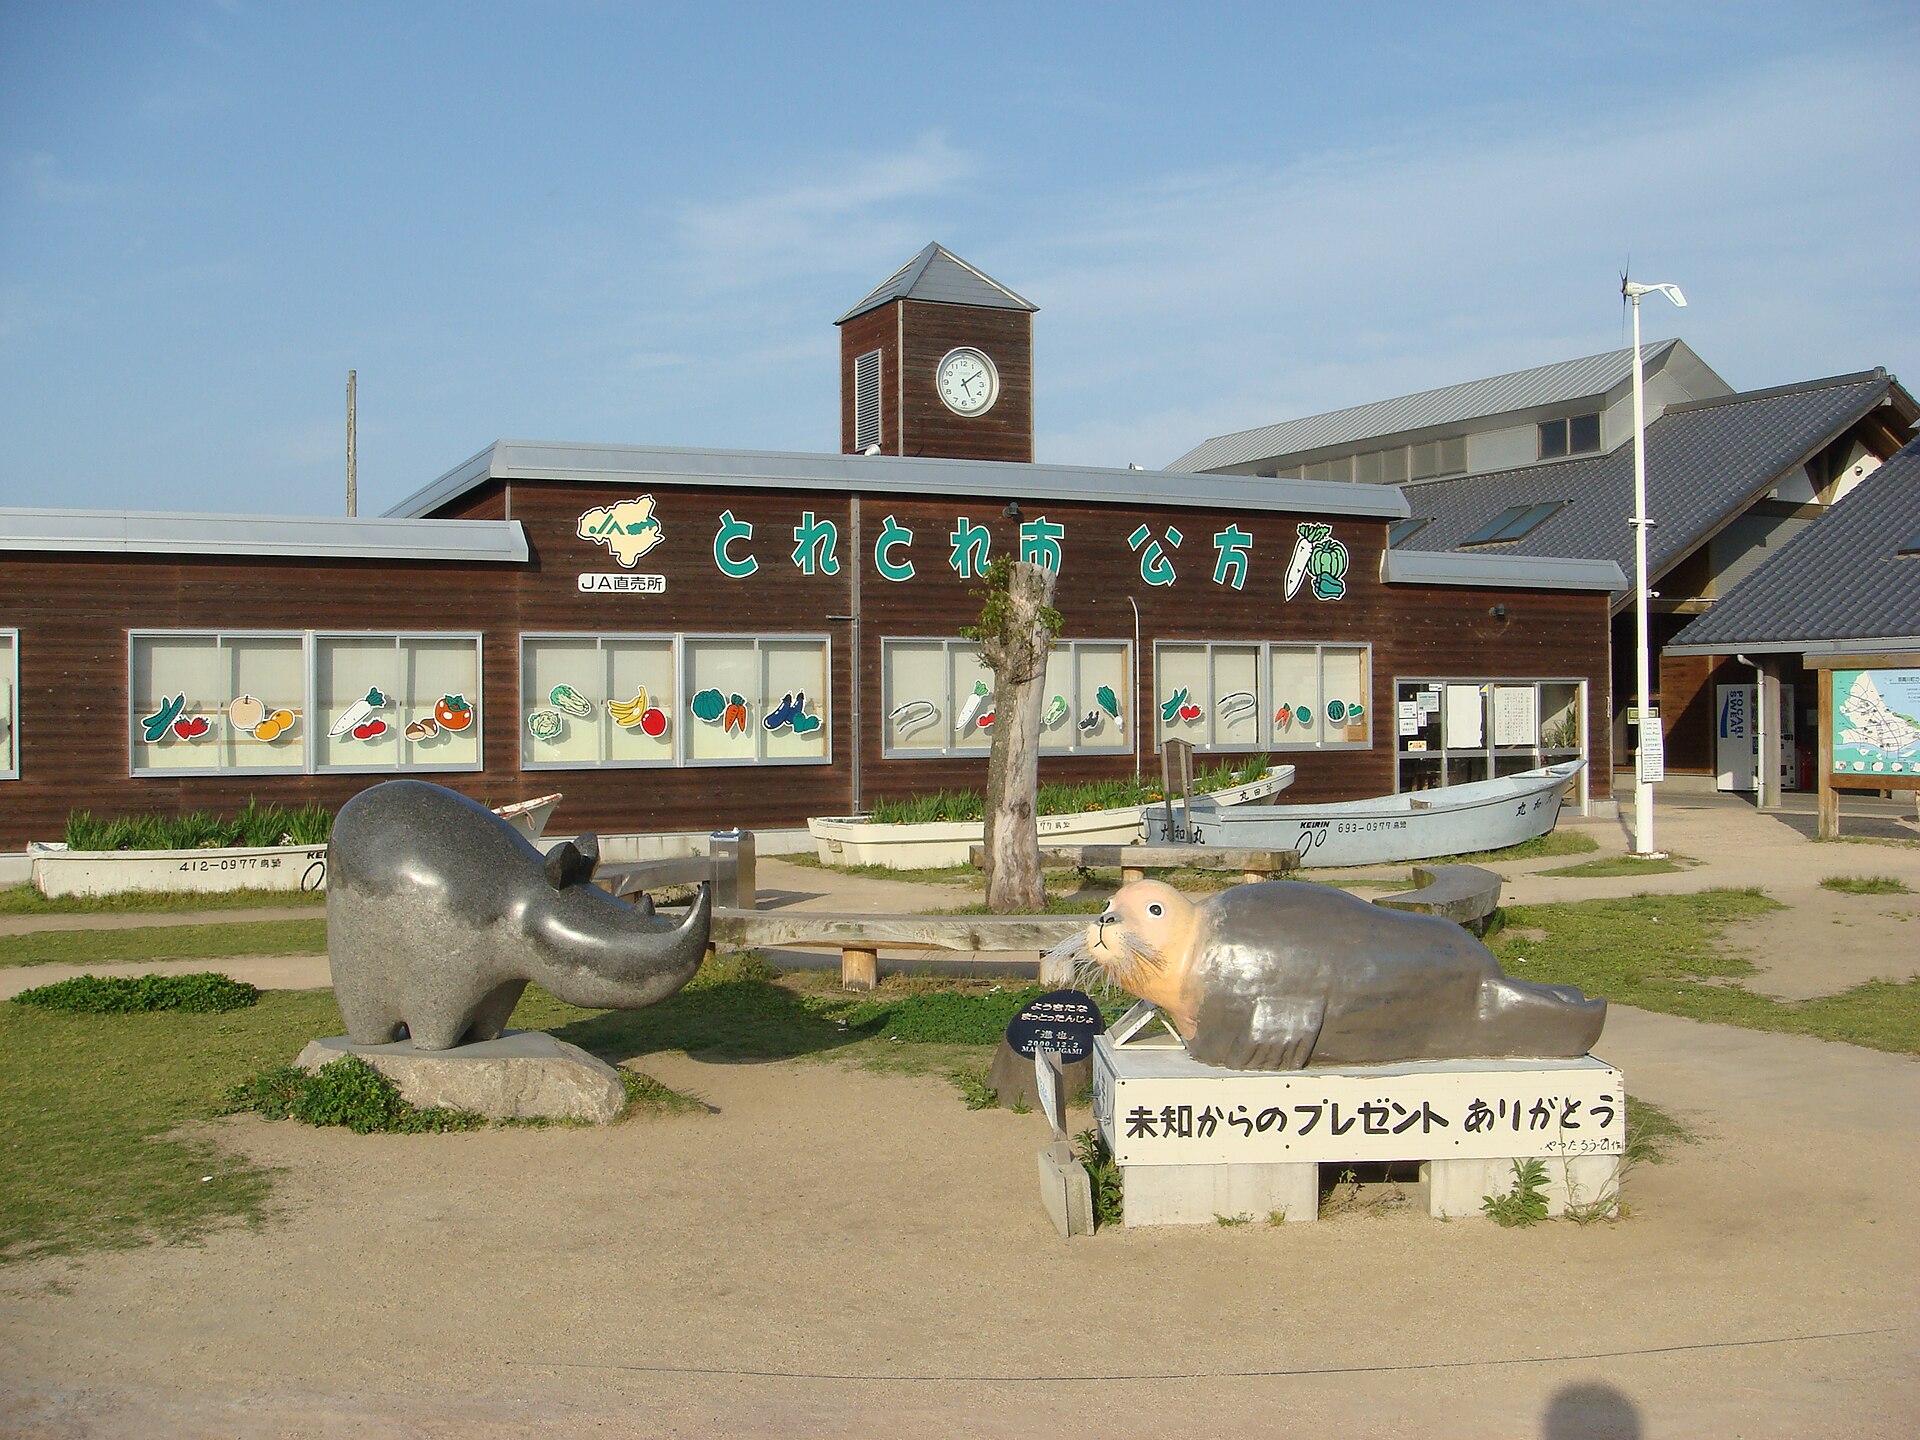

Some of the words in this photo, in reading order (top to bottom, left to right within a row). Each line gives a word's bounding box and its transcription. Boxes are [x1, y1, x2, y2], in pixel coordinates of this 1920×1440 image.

[713, 509, 1065, 582] とれとれ市
[1127, 523, 1253, 591] 公方
[582, 576, 662, 591] JA直売所
[1338, 822, 1390, 833] 693-0977
[180, 859, 257, 872] 412-0977
[1030, 1002, 1088, 1012] ようきたな
[1126, 1099, 1449, 1138] 未知からのプレゼント
[1464, 1094, 1614, 1132] ありがとう
